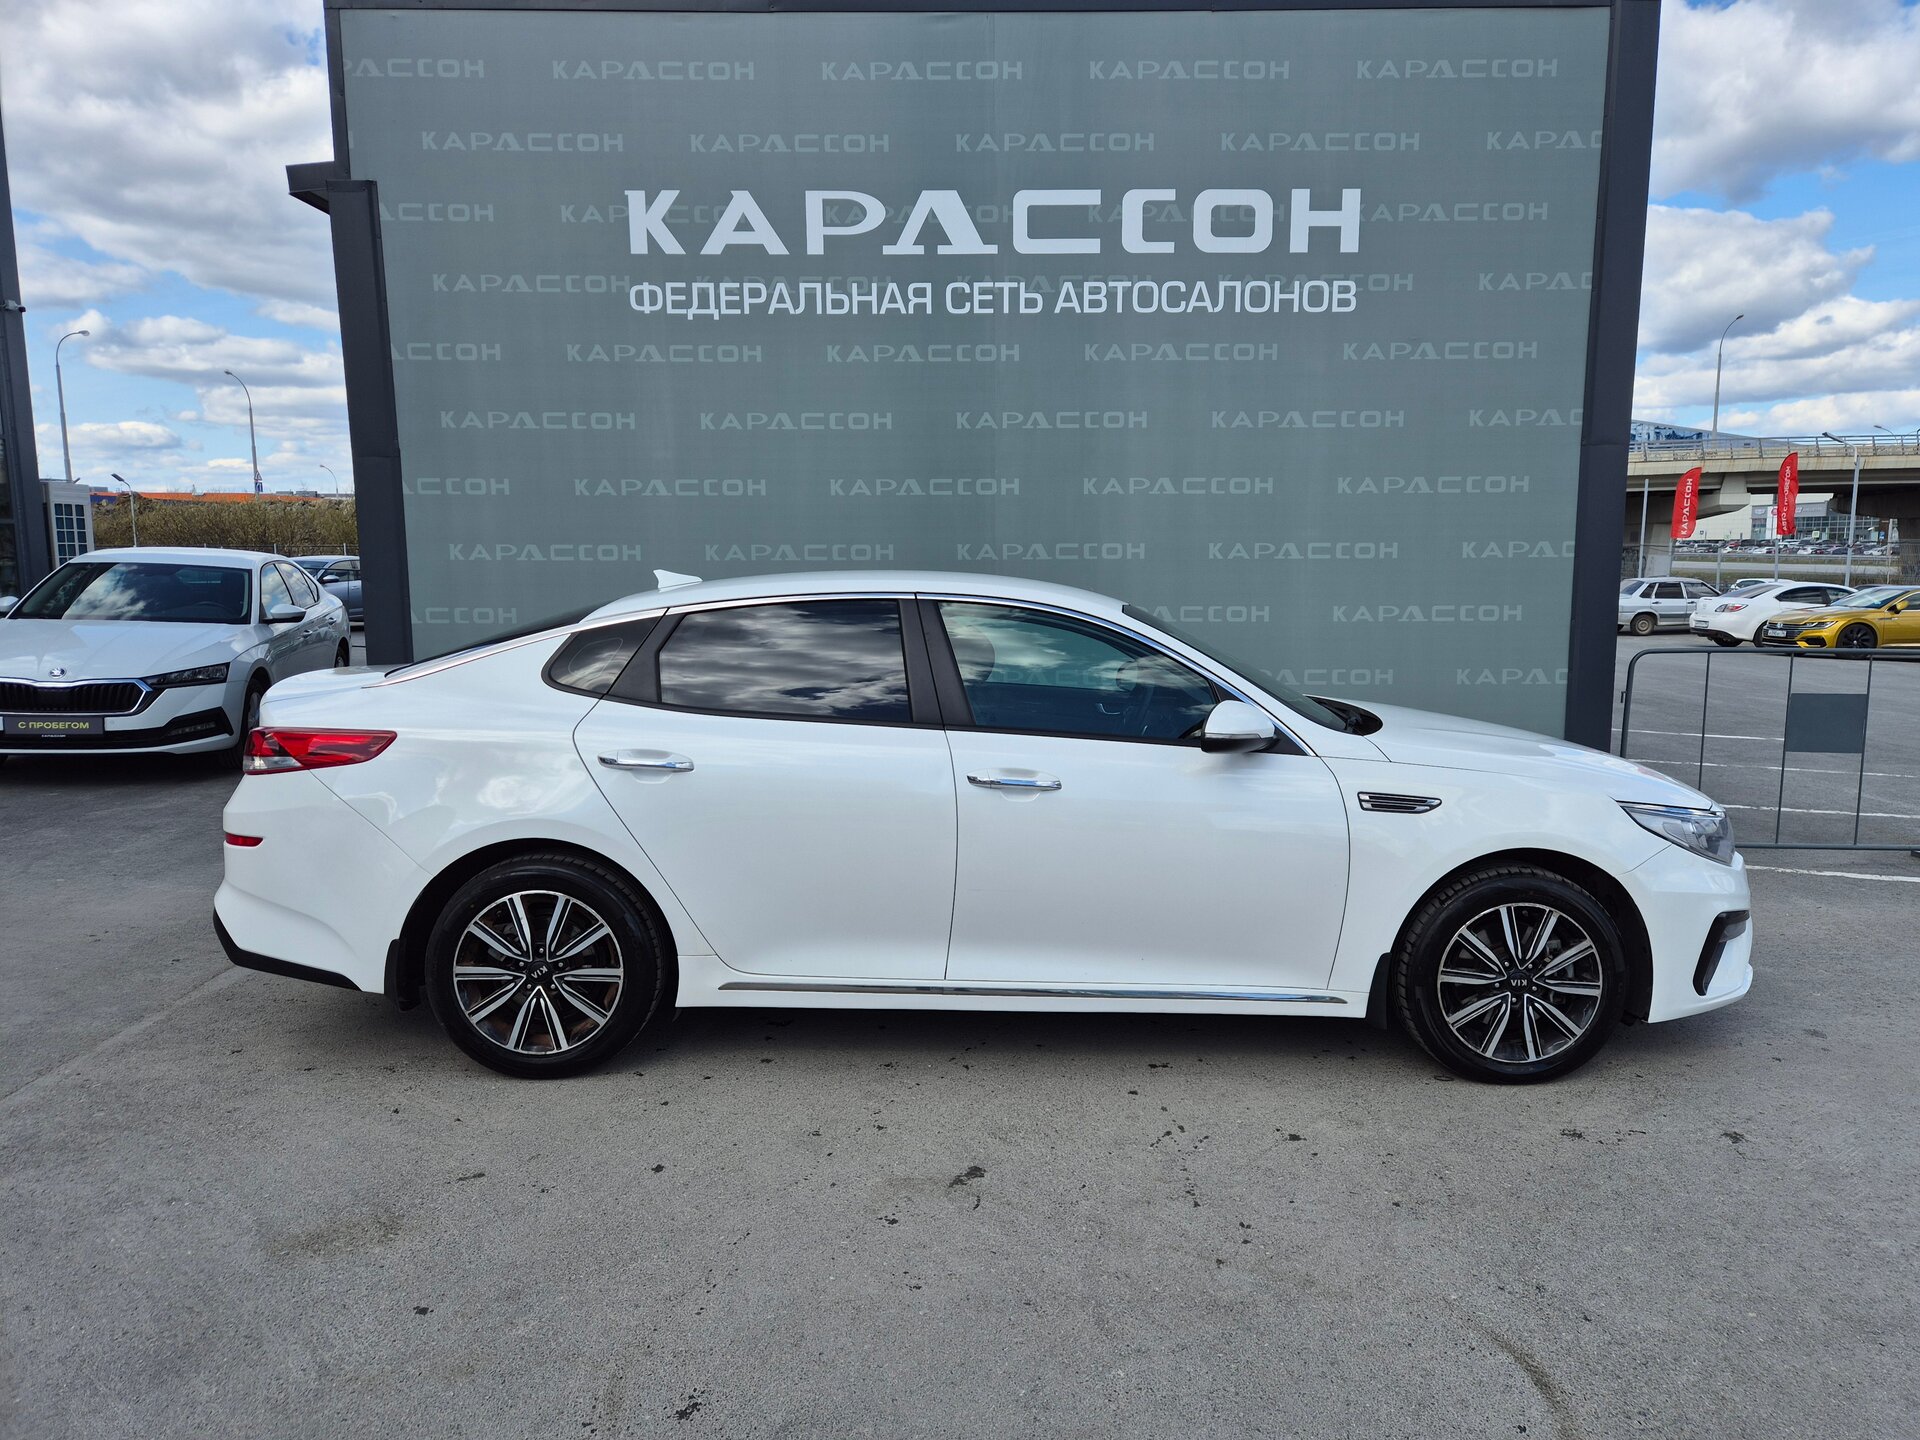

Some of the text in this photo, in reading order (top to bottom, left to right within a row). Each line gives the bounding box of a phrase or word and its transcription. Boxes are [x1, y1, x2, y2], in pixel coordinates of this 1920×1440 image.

[629, 280, 1357, 320] ФЕДЕРАЛЬНАЯ СЕТЬ АВТОСАЛОНОВ
[18, 721, 89, 729] С ПРОБЕГОМ
